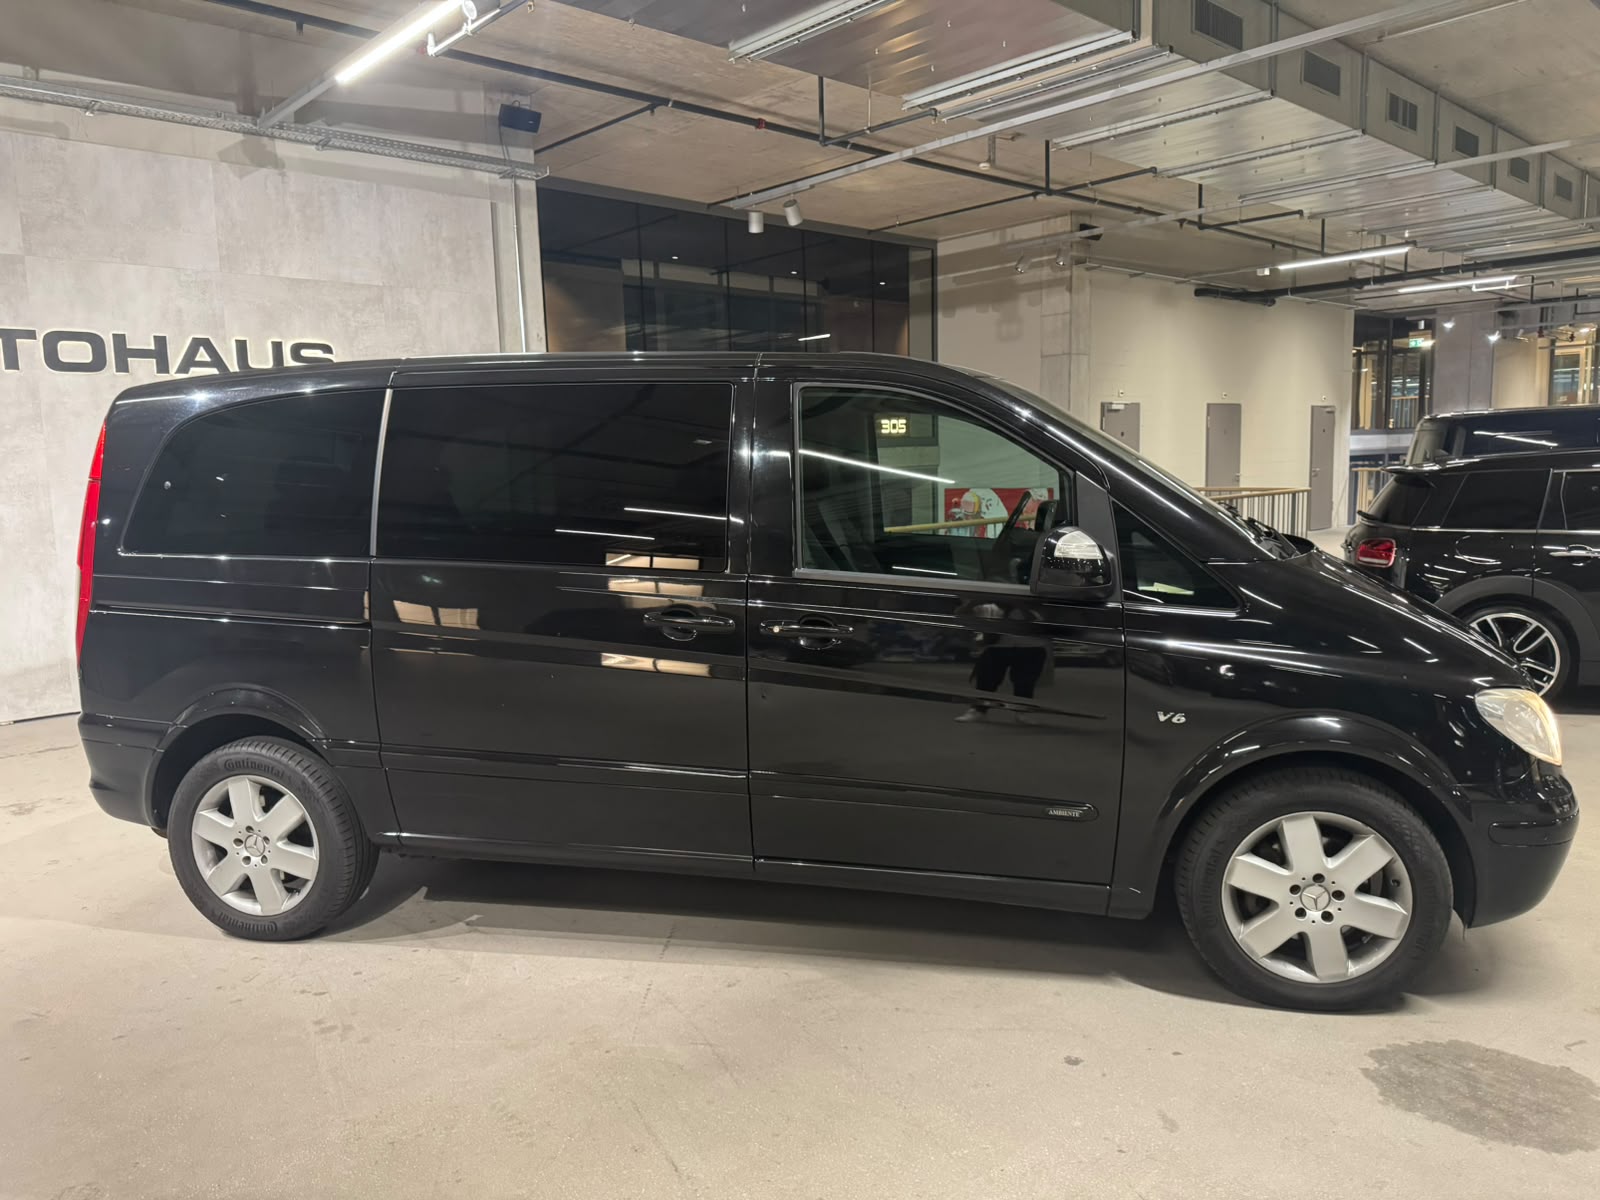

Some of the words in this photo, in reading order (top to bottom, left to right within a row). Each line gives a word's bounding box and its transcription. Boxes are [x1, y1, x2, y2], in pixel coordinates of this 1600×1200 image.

[881, 419, 907, 434] 305
[1157, 711, 1187, 724] V6
[224, 757, 285, 779] Continental
